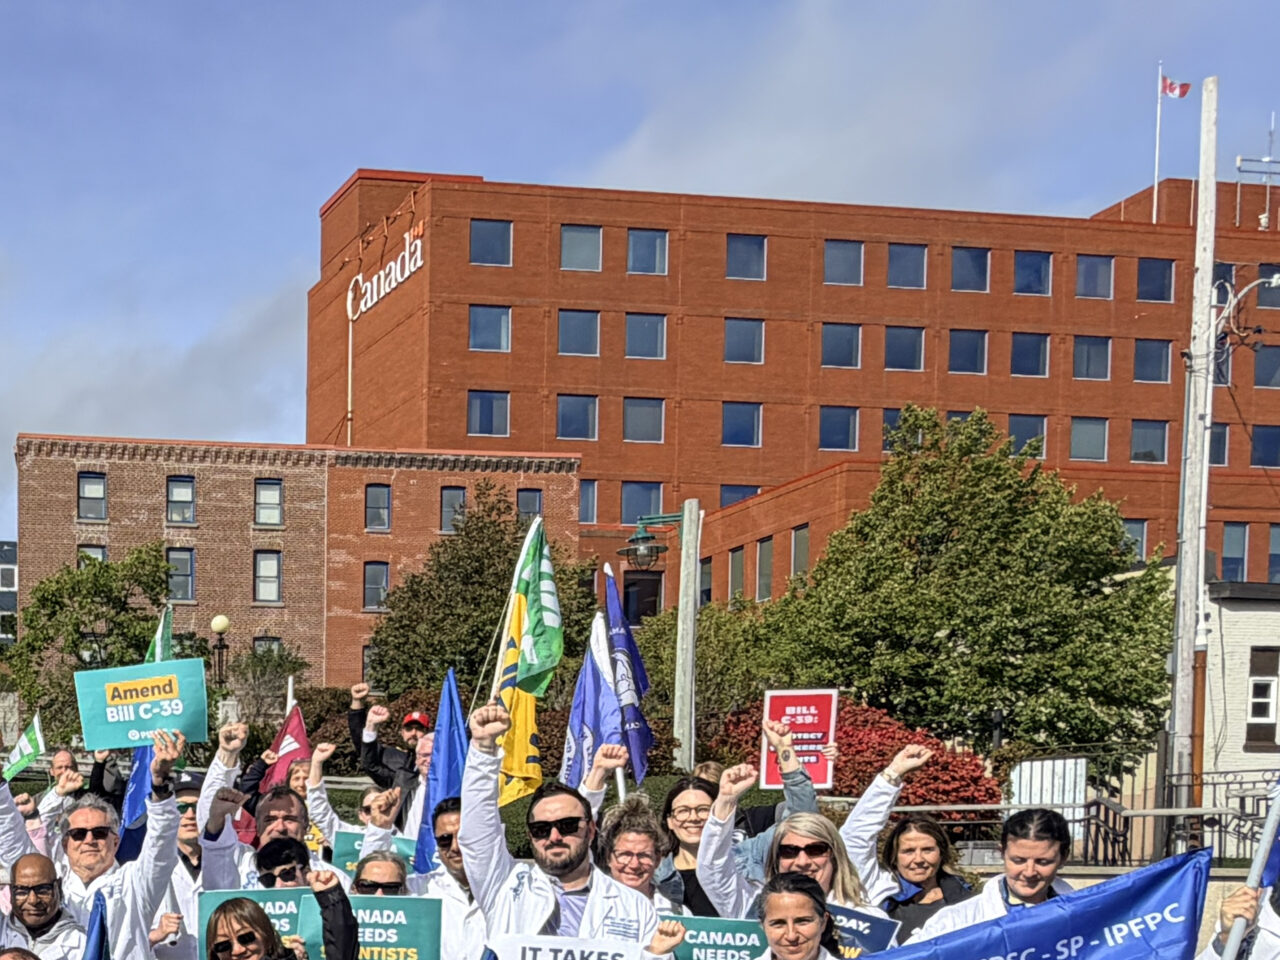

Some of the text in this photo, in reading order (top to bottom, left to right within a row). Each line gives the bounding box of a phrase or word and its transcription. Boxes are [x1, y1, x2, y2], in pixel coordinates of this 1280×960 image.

[346, 230, 424, 321] Canada
[111, 679, 173, 701] Amend
[106, 699, 183, 723] Bill C-39
[781, 715, 819, 724] C-39:
[785, 706, 818, 715] BILL
[354, 909, 408, 925] NADA
[834, 915, 871, 934] DAY,
[358, 927, 399, 944] EEDS
[684, 930, 760, 947] CANADA
[1055, 935, 1084, 960] SP
[1104, 902, 1186, 947] IPFPC
